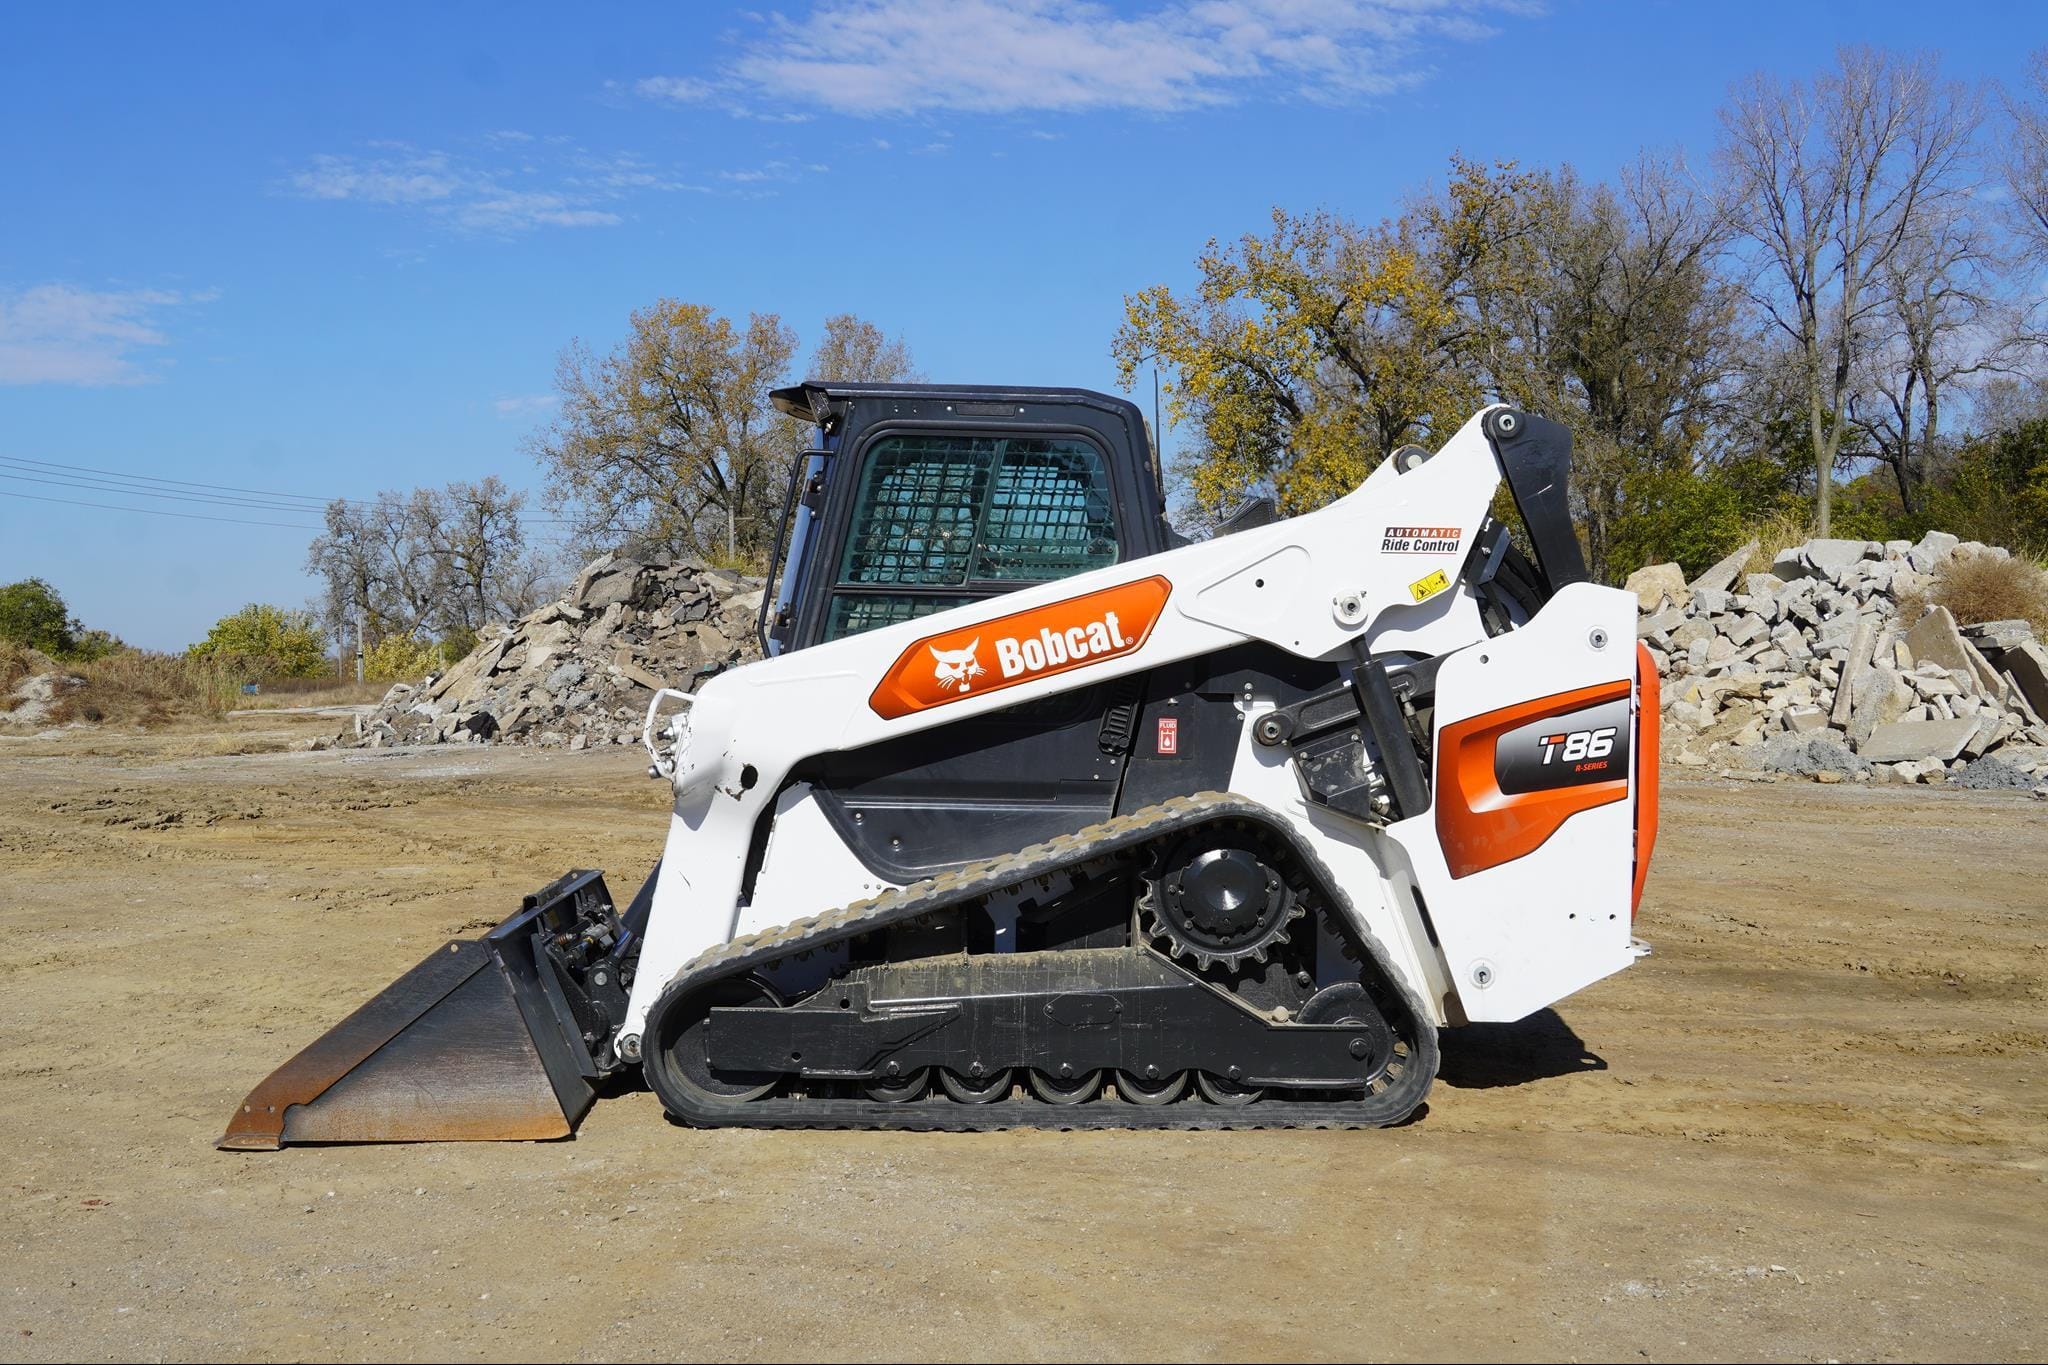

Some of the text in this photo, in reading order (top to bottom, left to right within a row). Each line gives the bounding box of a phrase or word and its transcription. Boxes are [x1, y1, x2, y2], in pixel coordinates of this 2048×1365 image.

[1387, 528, 1460, 538] AUTOMATIC
[1381, 539, 1460, 552] Ride Control
[995, 611, 1126, 679] Bobcat
[1538, 727, 1617, 766] T86
[1575, 761, 1609, 773] R-SERIES
